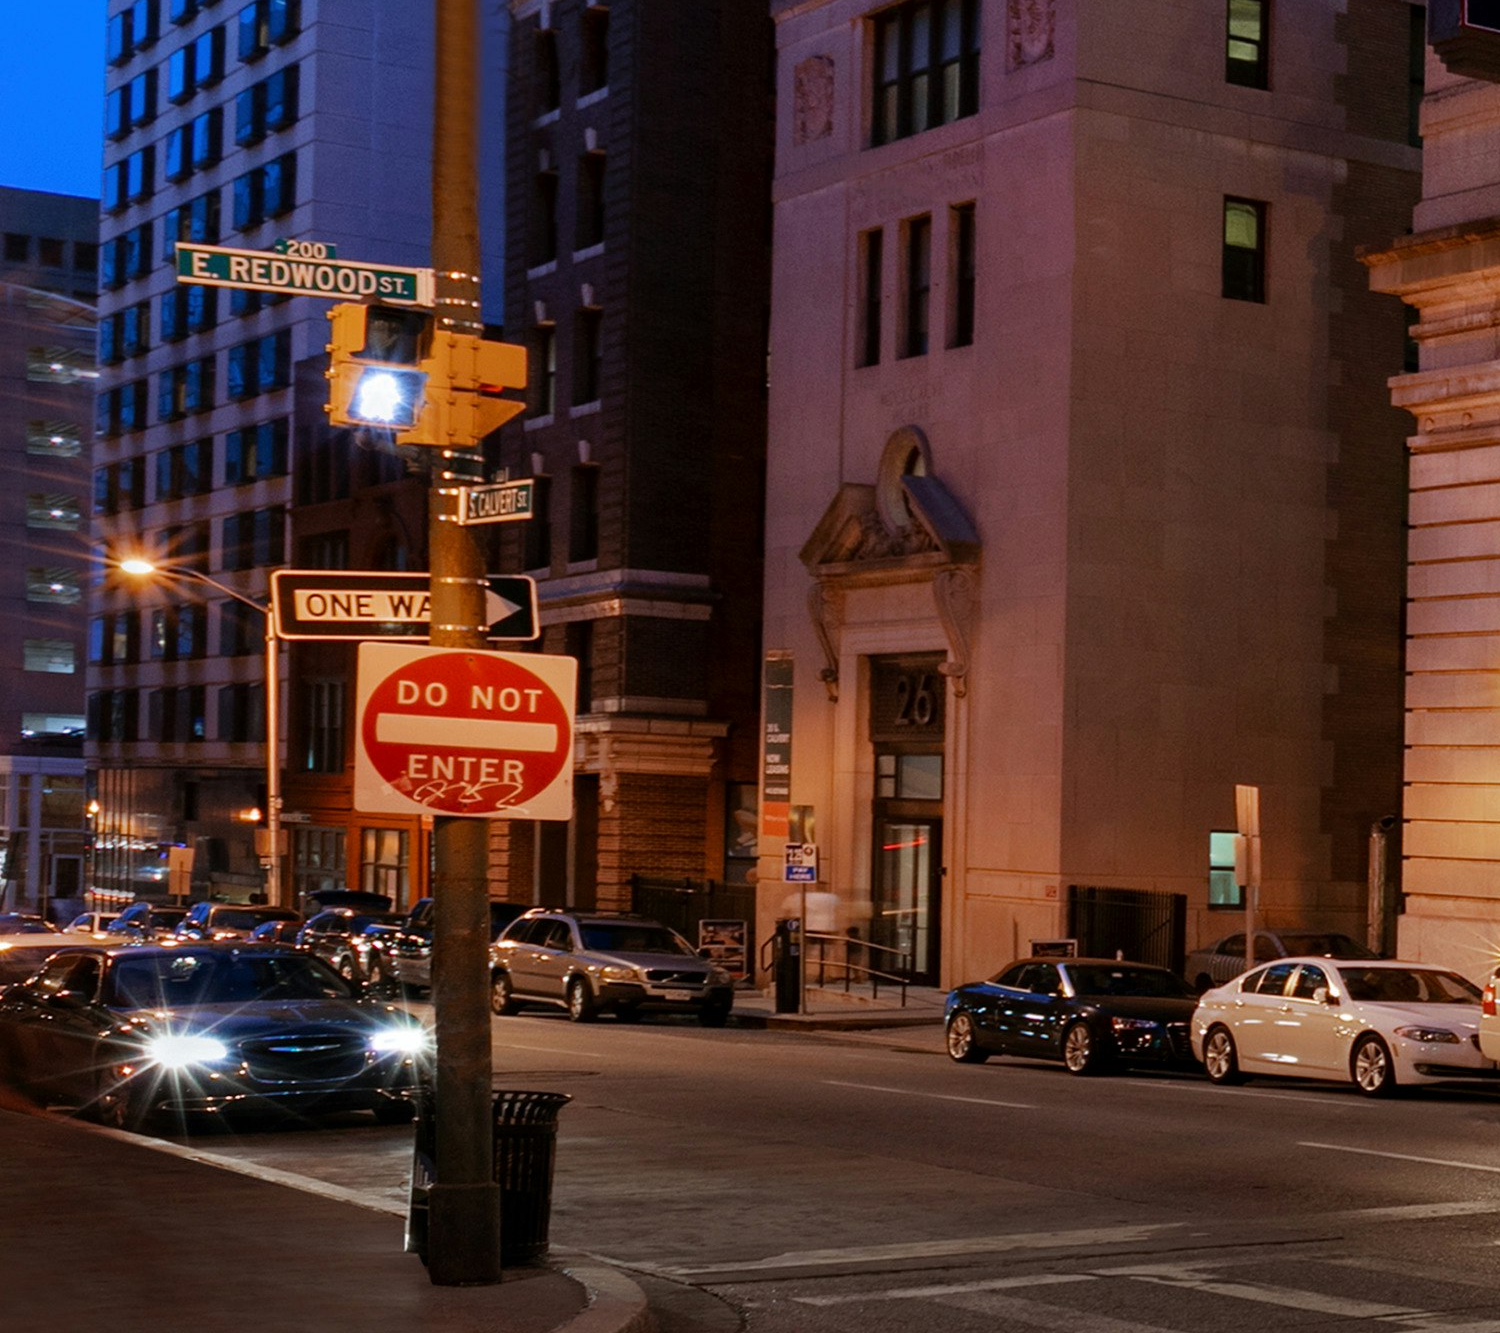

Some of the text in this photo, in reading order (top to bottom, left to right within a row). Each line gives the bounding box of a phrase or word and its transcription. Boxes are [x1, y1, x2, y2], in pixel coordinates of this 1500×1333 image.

[286, 240, 328, 260] 200
[191, 252, 409, 295] E. REDWOOD ST.
[478, 488, 518, 517] CALVERT
[305, 594, 431, 618] ONE WA
[397, 680, 543, 713] DO NOT
[407, 754, 525, 784] ENTER
